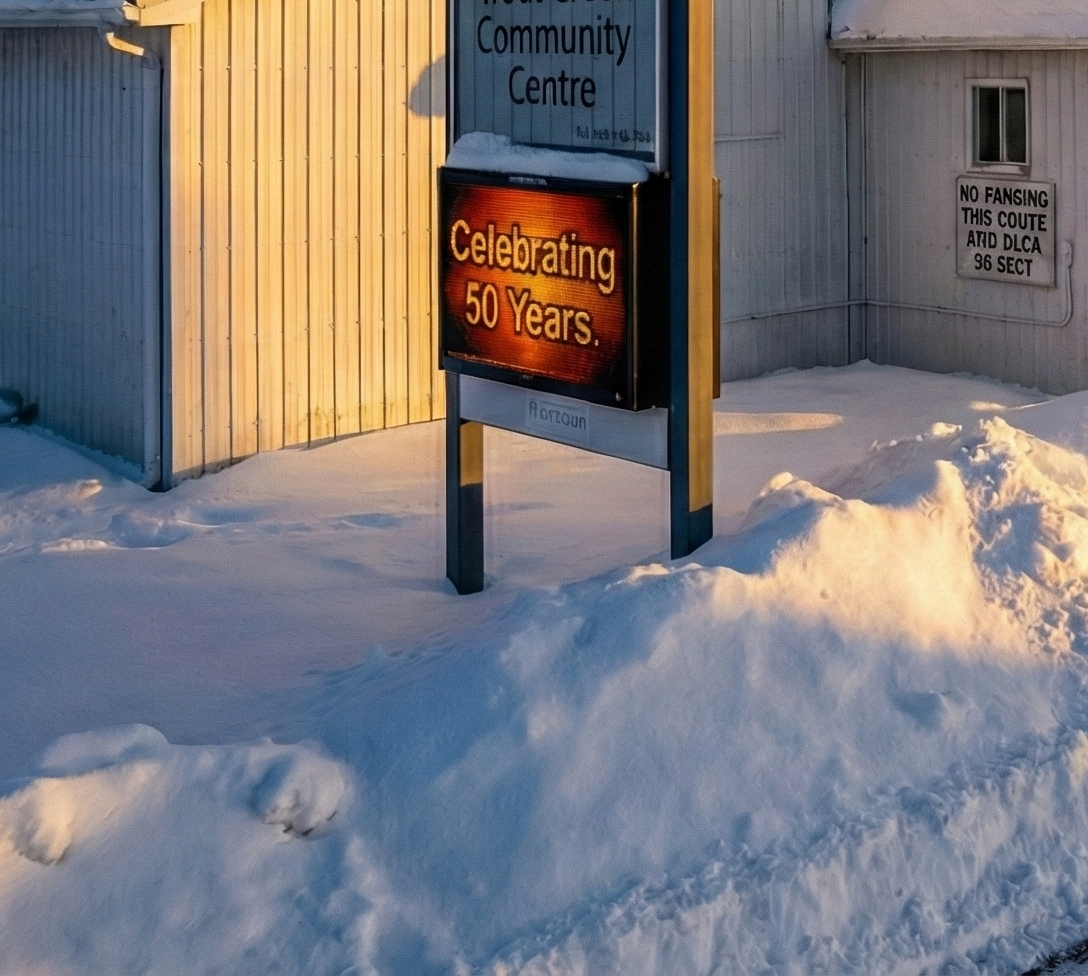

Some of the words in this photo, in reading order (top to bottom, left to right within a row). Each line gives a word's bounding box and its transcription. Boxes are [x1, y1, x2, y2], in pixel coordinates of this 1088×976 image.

[477, 15, 631, 66] Community
[508, 65, 596, 108] Centre
[960, 184, 979, 202] NO
[985, 186, 1048, 208] FANSING
[961, 206, 993, 226] THIS
[997, 210, 1047, 232] COUTE
[451, 219, 616, 295] Celebrating
[1003, 232, 1042, 255] DLCA
[997, 255, 1033, 277] SECT
[465, 281, 498, 328] 50
[507, 288, 599, 346] Years.
